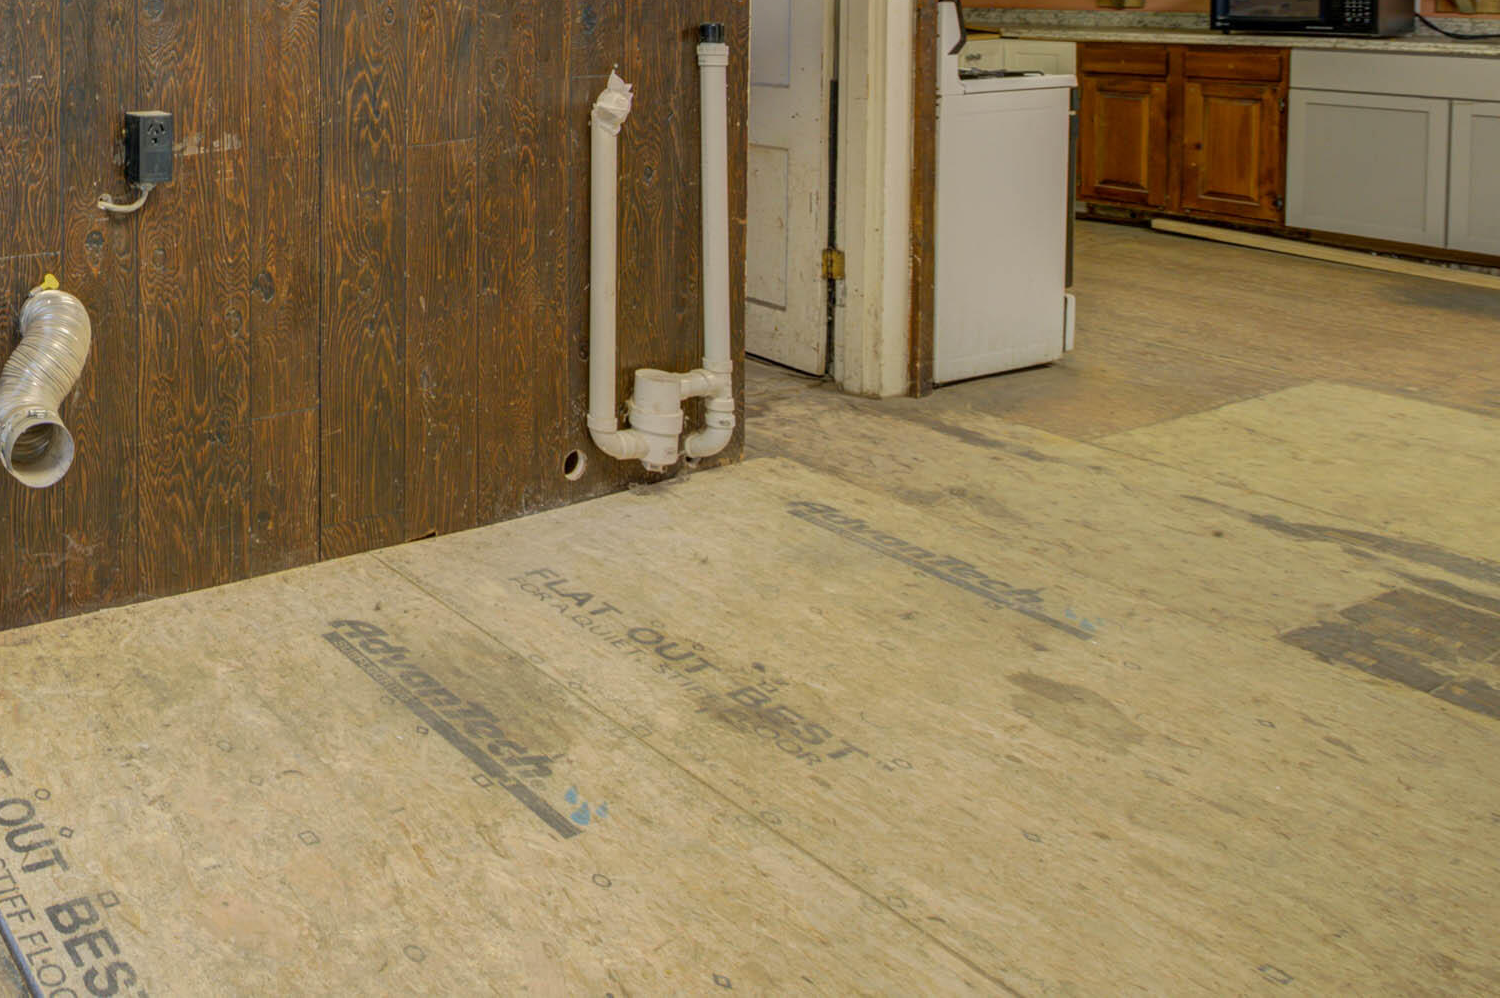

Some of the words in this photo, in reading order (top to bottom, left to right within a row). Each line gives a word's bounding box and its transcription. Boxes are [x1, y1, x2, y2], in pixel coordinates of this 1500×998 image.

[508, 577, 552, 601] FOR
[327, 619, 555, 778] AdvanTech
[524, 568, 624, 615] FLAT
[627, 627, 722, 673] OUT
[727, 686, 870, 759] BEST
[44, 897, 150, 998] BES
